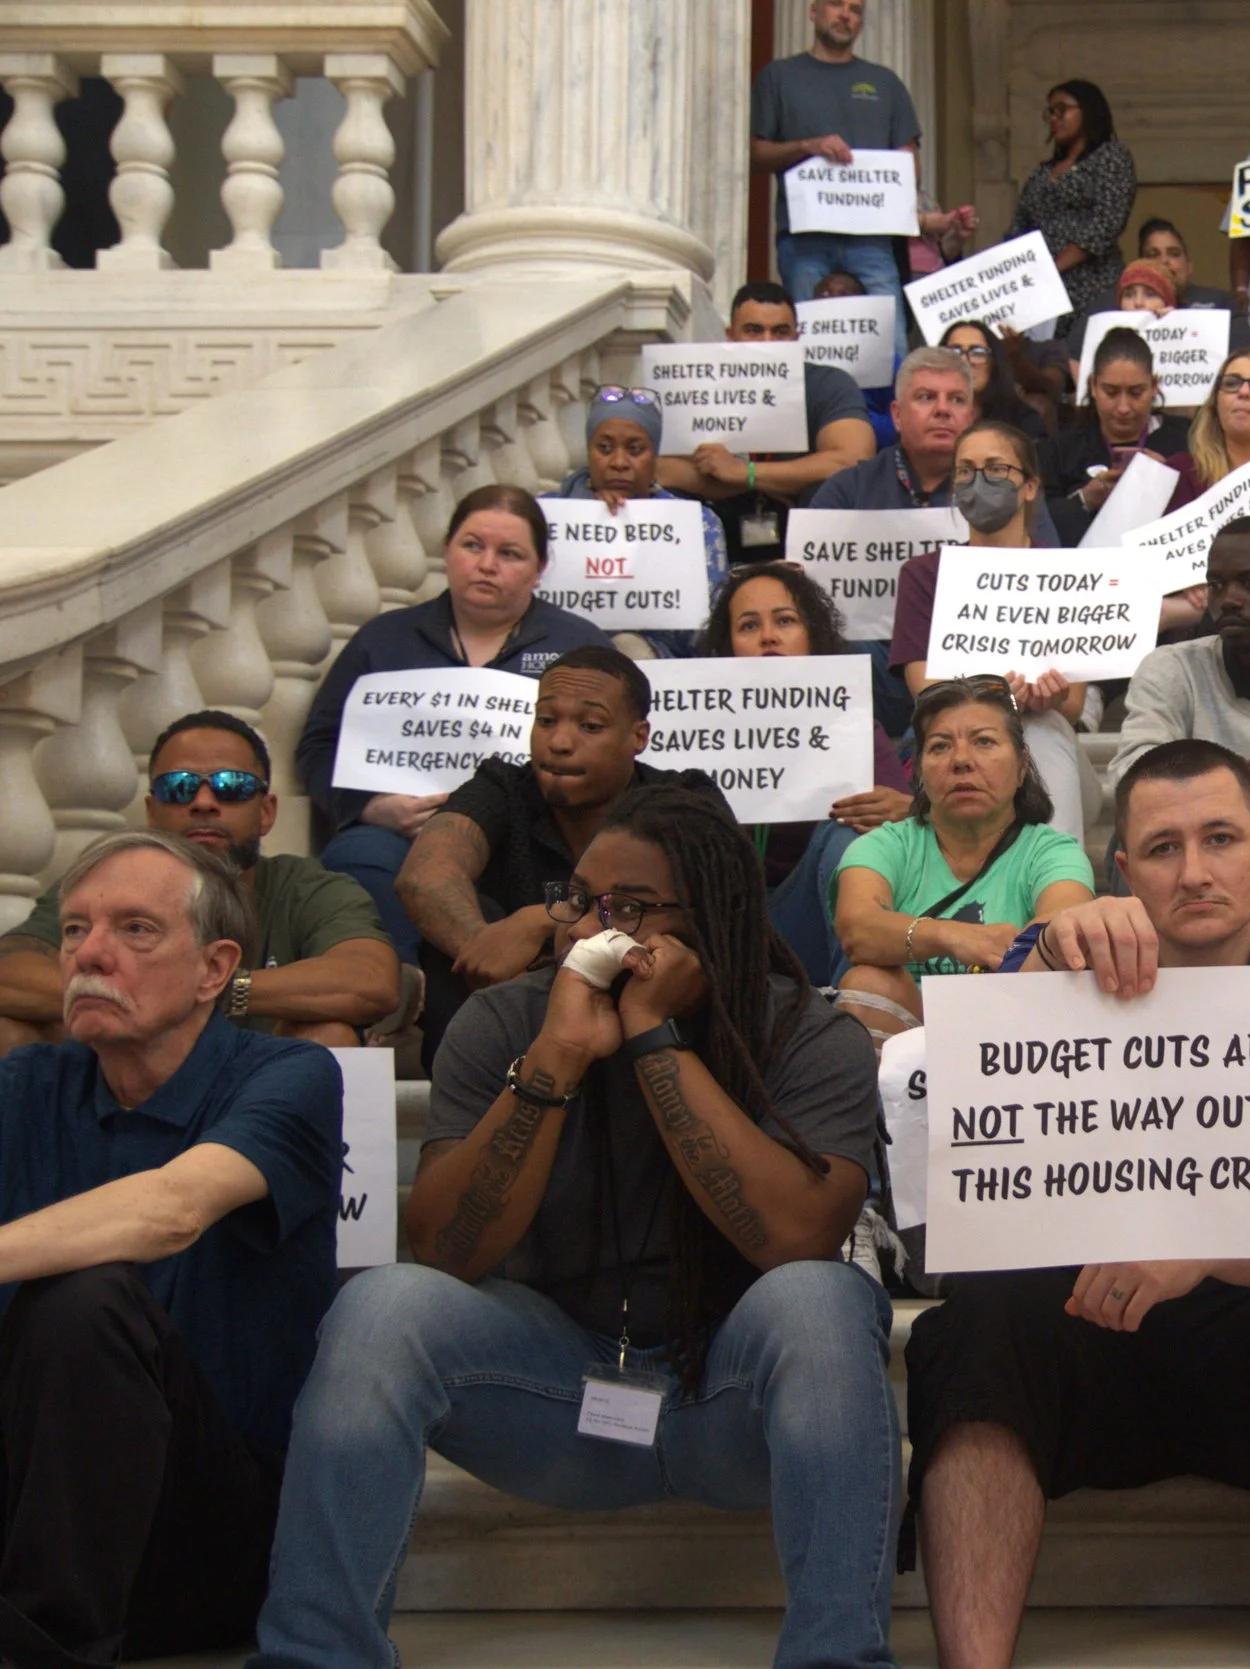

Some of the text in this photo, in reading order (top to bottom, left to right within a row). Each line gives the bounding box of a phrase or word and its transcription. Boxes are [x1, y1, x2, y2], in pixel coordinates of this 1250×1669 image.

[798, 168, 902, 186] SAVE SHELTER
[818, 191, 885, 209] FUNDING!
[920, 249, 1036, 309] SHELTER FUNDING
[939, 275, 1035, 324] SAVES LIVES &
[982, 303, 1016, 326] ONEY
[811, 318, 880, 336] SHELTER
[1145, 327, 1188, 342] TODAY
[805, 345, 859, 362] NDING!
[1160, 350, 1209, 366] BIGGER
[653, 362, 790, 381] SHELTER FUNDING
[665, 389, 776, 407] SAVES LIVES &
[691, 417, 747, 432] MONEY
[566, 523, 618, 543] NEED
[624, 523, 681, 545] BEDS,
[804, 541, 859, 562] SAVE
[1165, 539, 1207, 561] AVES
[585, 557, 630, 579] NOT
[831, 578, 896, 598] FUNDI
[977, 572, 1029, 591] CUTS
[1037, 572, 1103, 592] TODAY
[624, 589, 681, 610] CUTS!
[957, 603, 1131, 625] AN EVEN BIGGER
[941, 633, 1137, 657] CRISIS TOMORROW
[362, 691, 535, 715] EVERY $1 IN SHEL
[650, 686, 852, 714] HELTER FUNDING
[401, 719, 522, 740] SAVES $4 IN
[650, 726, 830, 752] SAVES LIVES &
[365, 748, 484, 772] EMERGENCY
[979, 1036, 1112, 1078] BUDGET
[1123, 1033, 1210, 1070] CUTS
[491, 1071, 556, 1162] Reasn
[951, 1103, 1025, 1147] NOT
[1034, 1099, 1099, 1136] THE
[1110, 1096, 1184, 1131] WAY
[952, 1166, 1032, 1202] THIS
[1044, 1156, 1202, 1197] HOUSING
